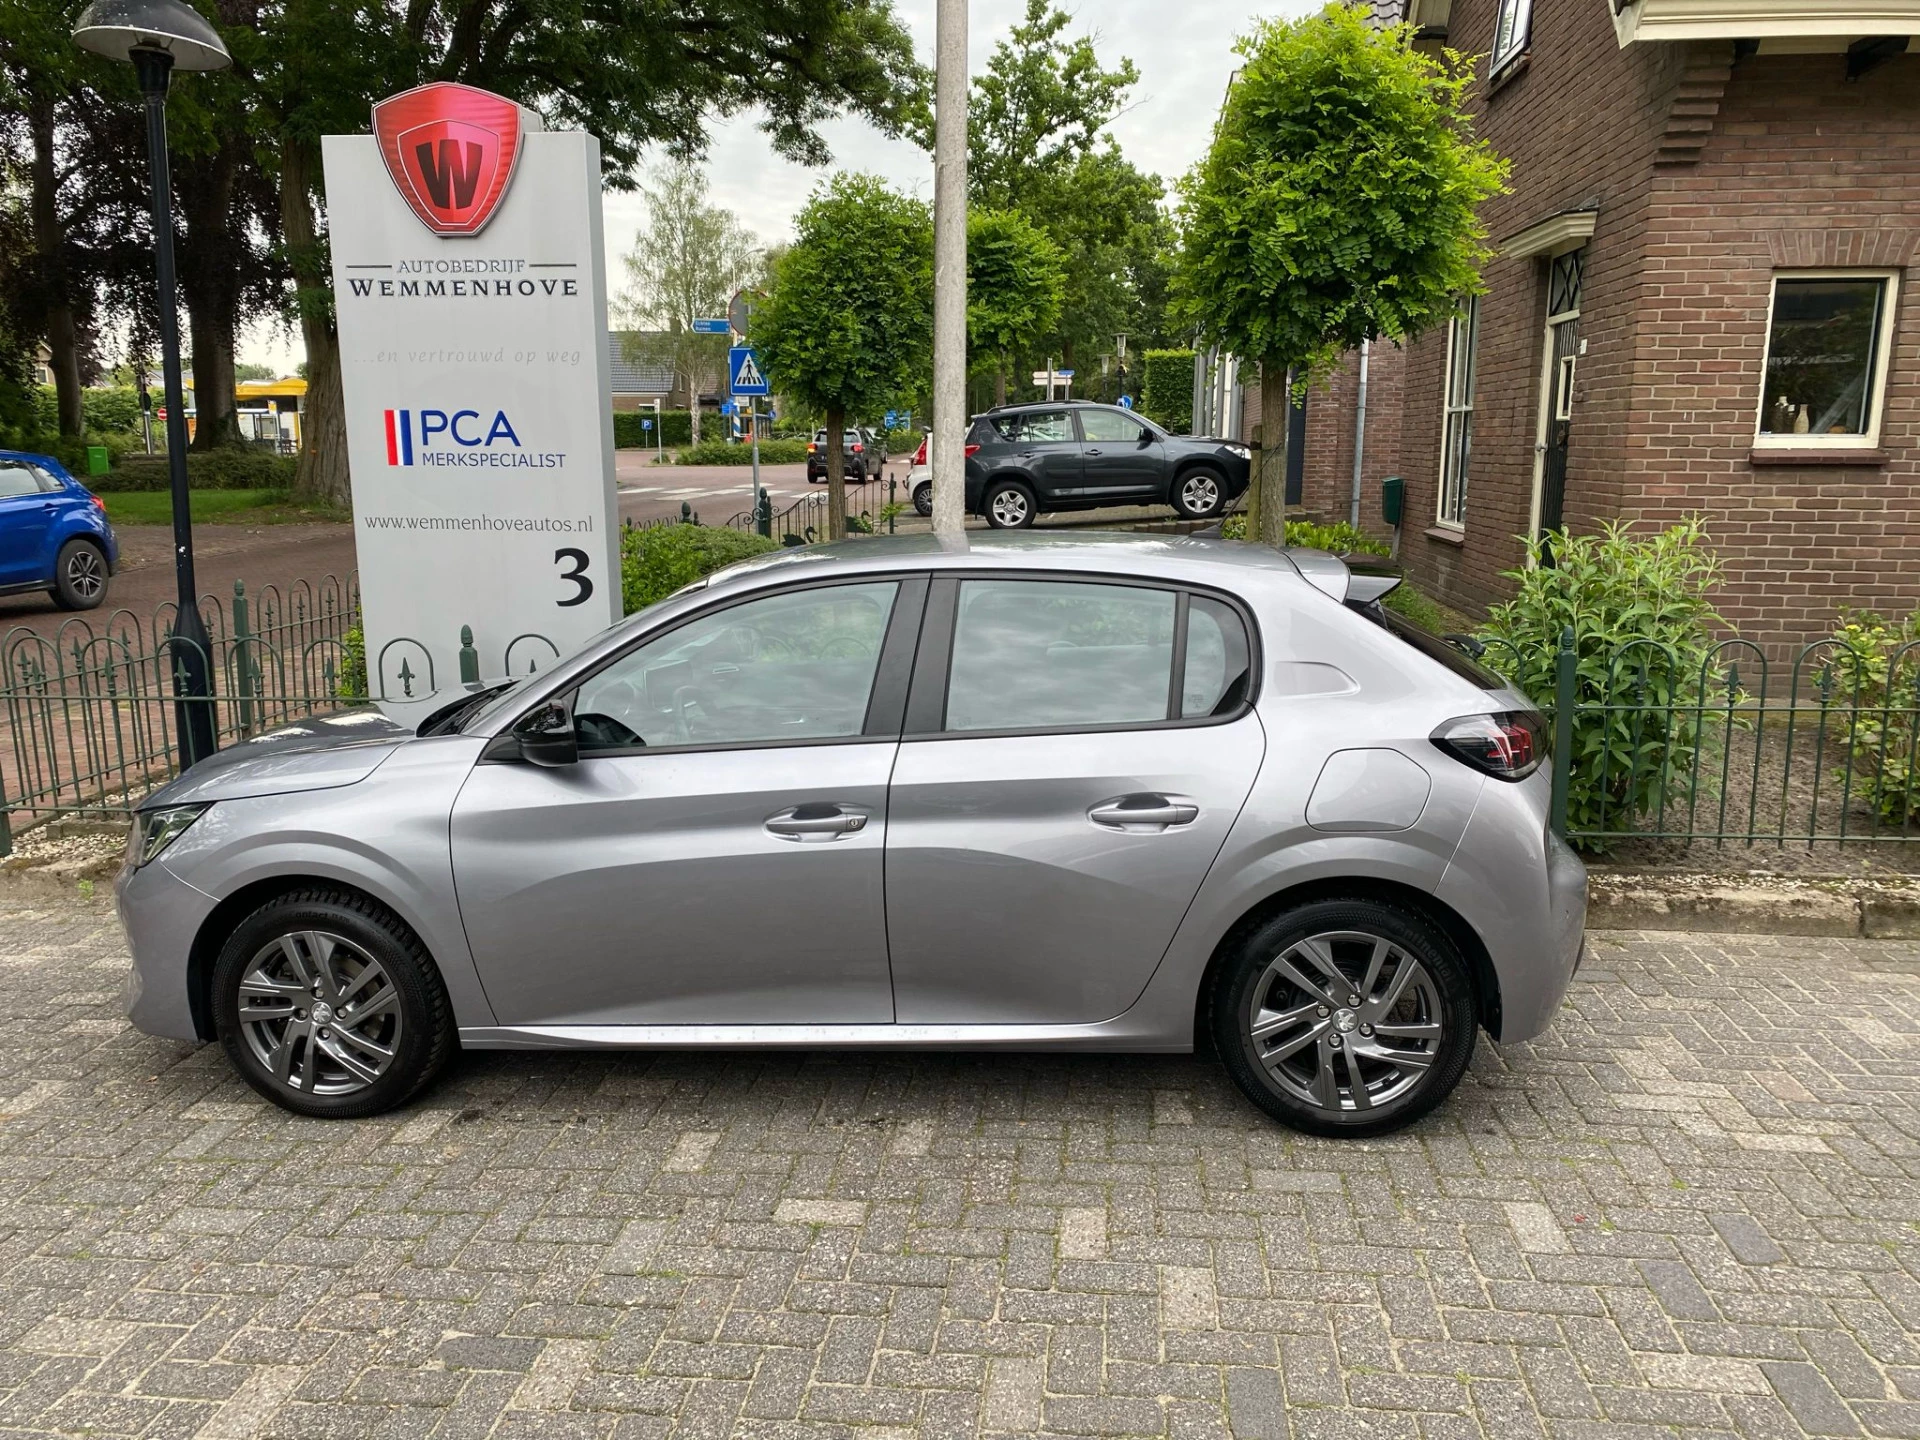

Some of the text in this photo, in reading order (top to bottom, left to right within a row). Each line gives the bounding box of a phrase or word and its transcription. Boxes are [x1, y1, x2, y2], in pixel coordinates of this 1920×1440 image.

[415, 139, 483, 210] W
[397, 259, 526, 274] AUTOBEDRIJF
[347, 278, 579, 298] WEMMENHOVE
[408, 347, 505, 363] vertrouwd
[514, 350, 537, 365] op
[546, 350, 582, 366] weg
[420, 409, 522, 447] PCA
[422, 452, 567, 469] MERKSPECIALIST
[364, 514, 594, 532] www.wemmenhoveautos.nl
[554, 546, 595, 608] 3
